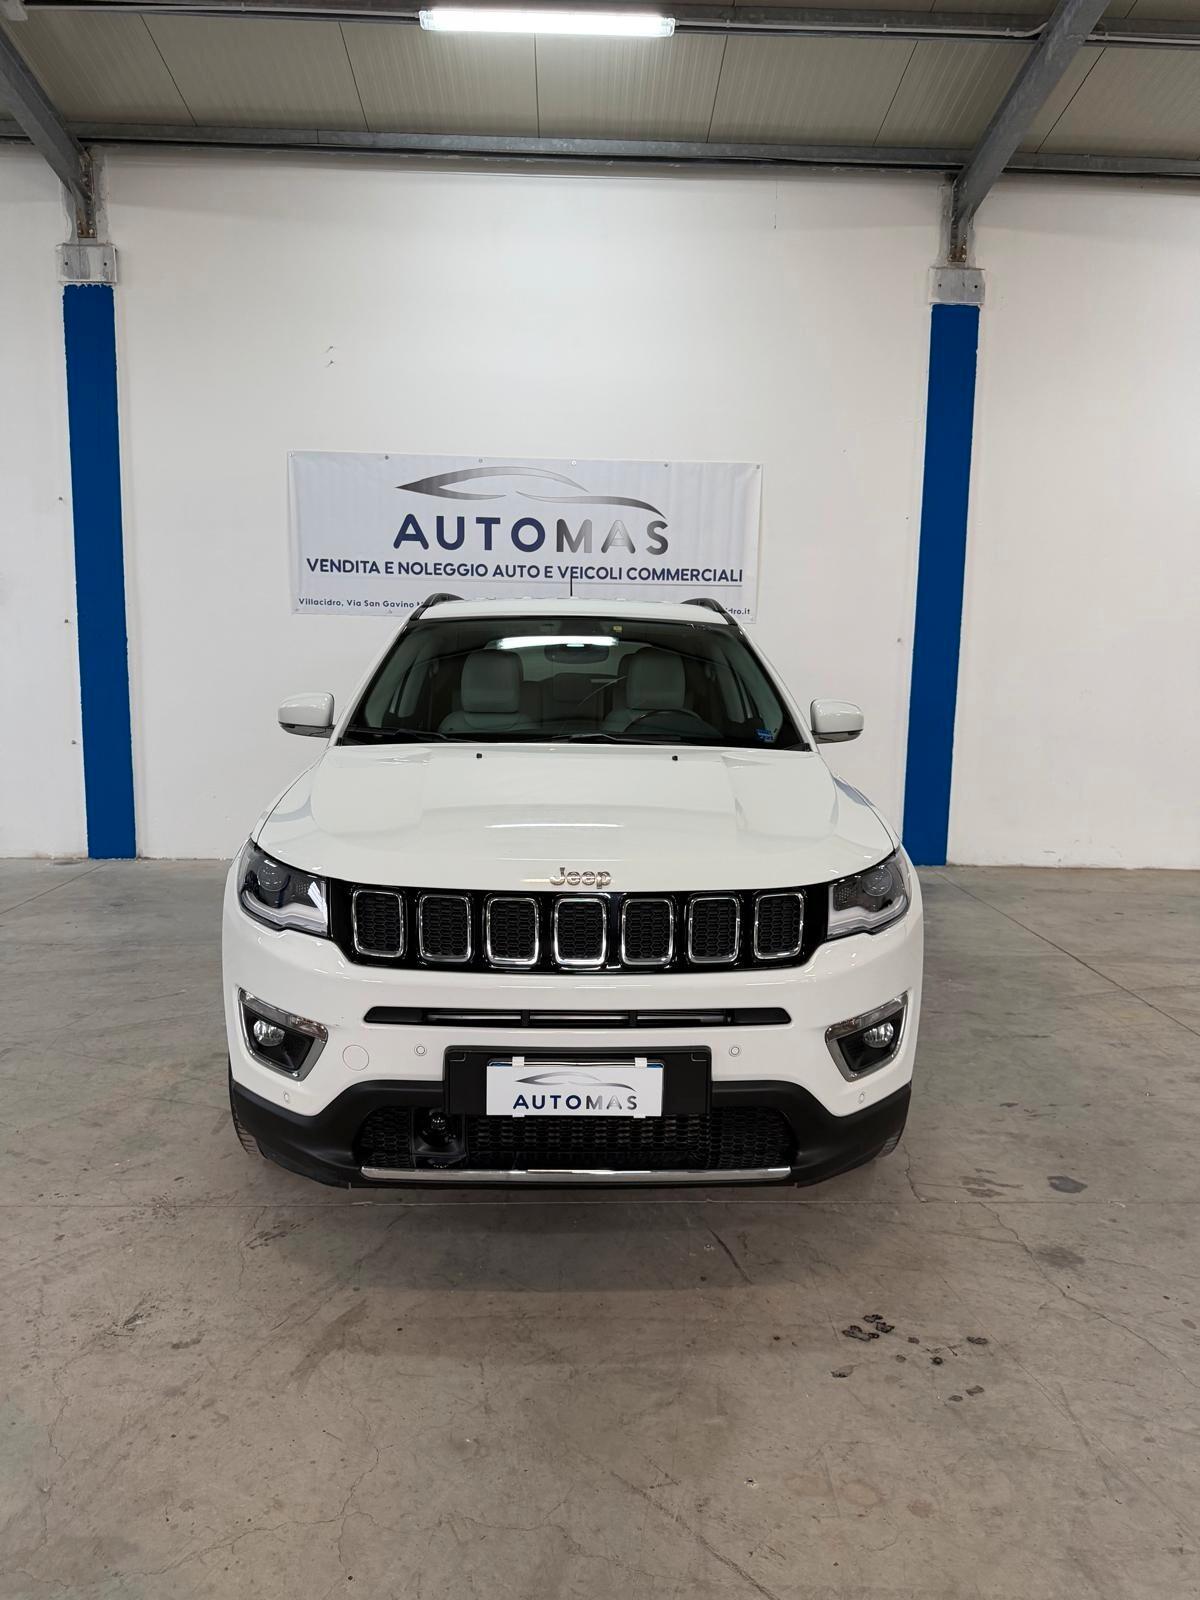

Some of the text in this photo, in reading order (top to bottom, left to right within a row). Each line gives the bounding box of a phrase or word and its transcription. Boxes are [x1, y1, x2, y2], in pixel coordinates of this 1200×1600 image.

[393, 513, 669, 556] AUTOMAS
[306, 557, 743, 583] VENDITA E NOLEGGIO AUTO E VEICOLI COMMERCIALI
[298, 598, 344, 607] Villacidro,
[346, 599, 363, 607] Via
[364, 600, 381, 608] San
[382, 600, 415, 608] Gavino
[549, 866, 611, 890] Jeep
[512, 1094, 638, 1110] AUTOMAS
